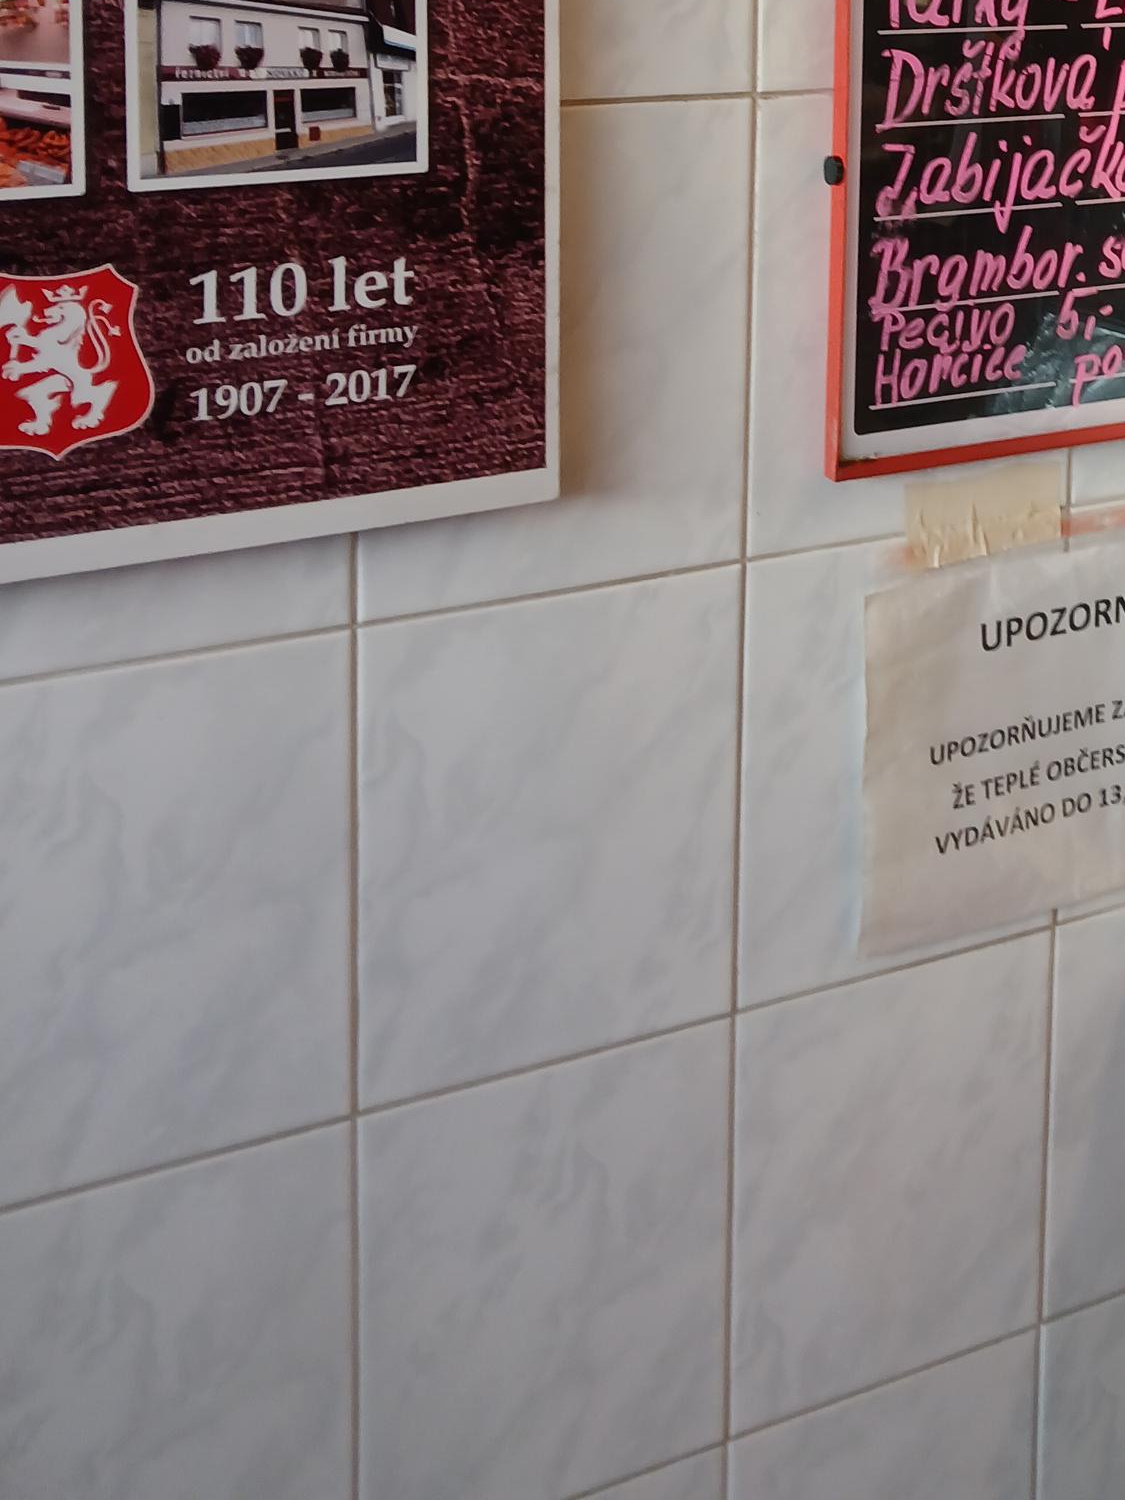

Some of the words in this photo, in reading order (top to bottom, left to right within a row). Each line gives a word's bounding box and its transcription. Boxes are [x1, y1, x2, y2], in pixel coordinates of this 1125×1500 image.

[189, 263, 308, 325] 110
[328, 255, 415, 312] let
[870, 225, 1086, 315] Brambor.
[186, 339, 221, 364] od
[228, 327, 340, 361] založení
[348, 323, 419, 348] firmy
[189, 379, 288, 421] 1907
[325, 364, 417, 406] 2017
[929, 702, 1107, 767] UPOZORŇUJEME
[951, 781, 976, 811] ŽE
[979, 760, 1042, 802] TEPLÉ
[935, 799, 1057, 856] VYDÁVÁNO
[1062, 789, 1093, 819] DO
